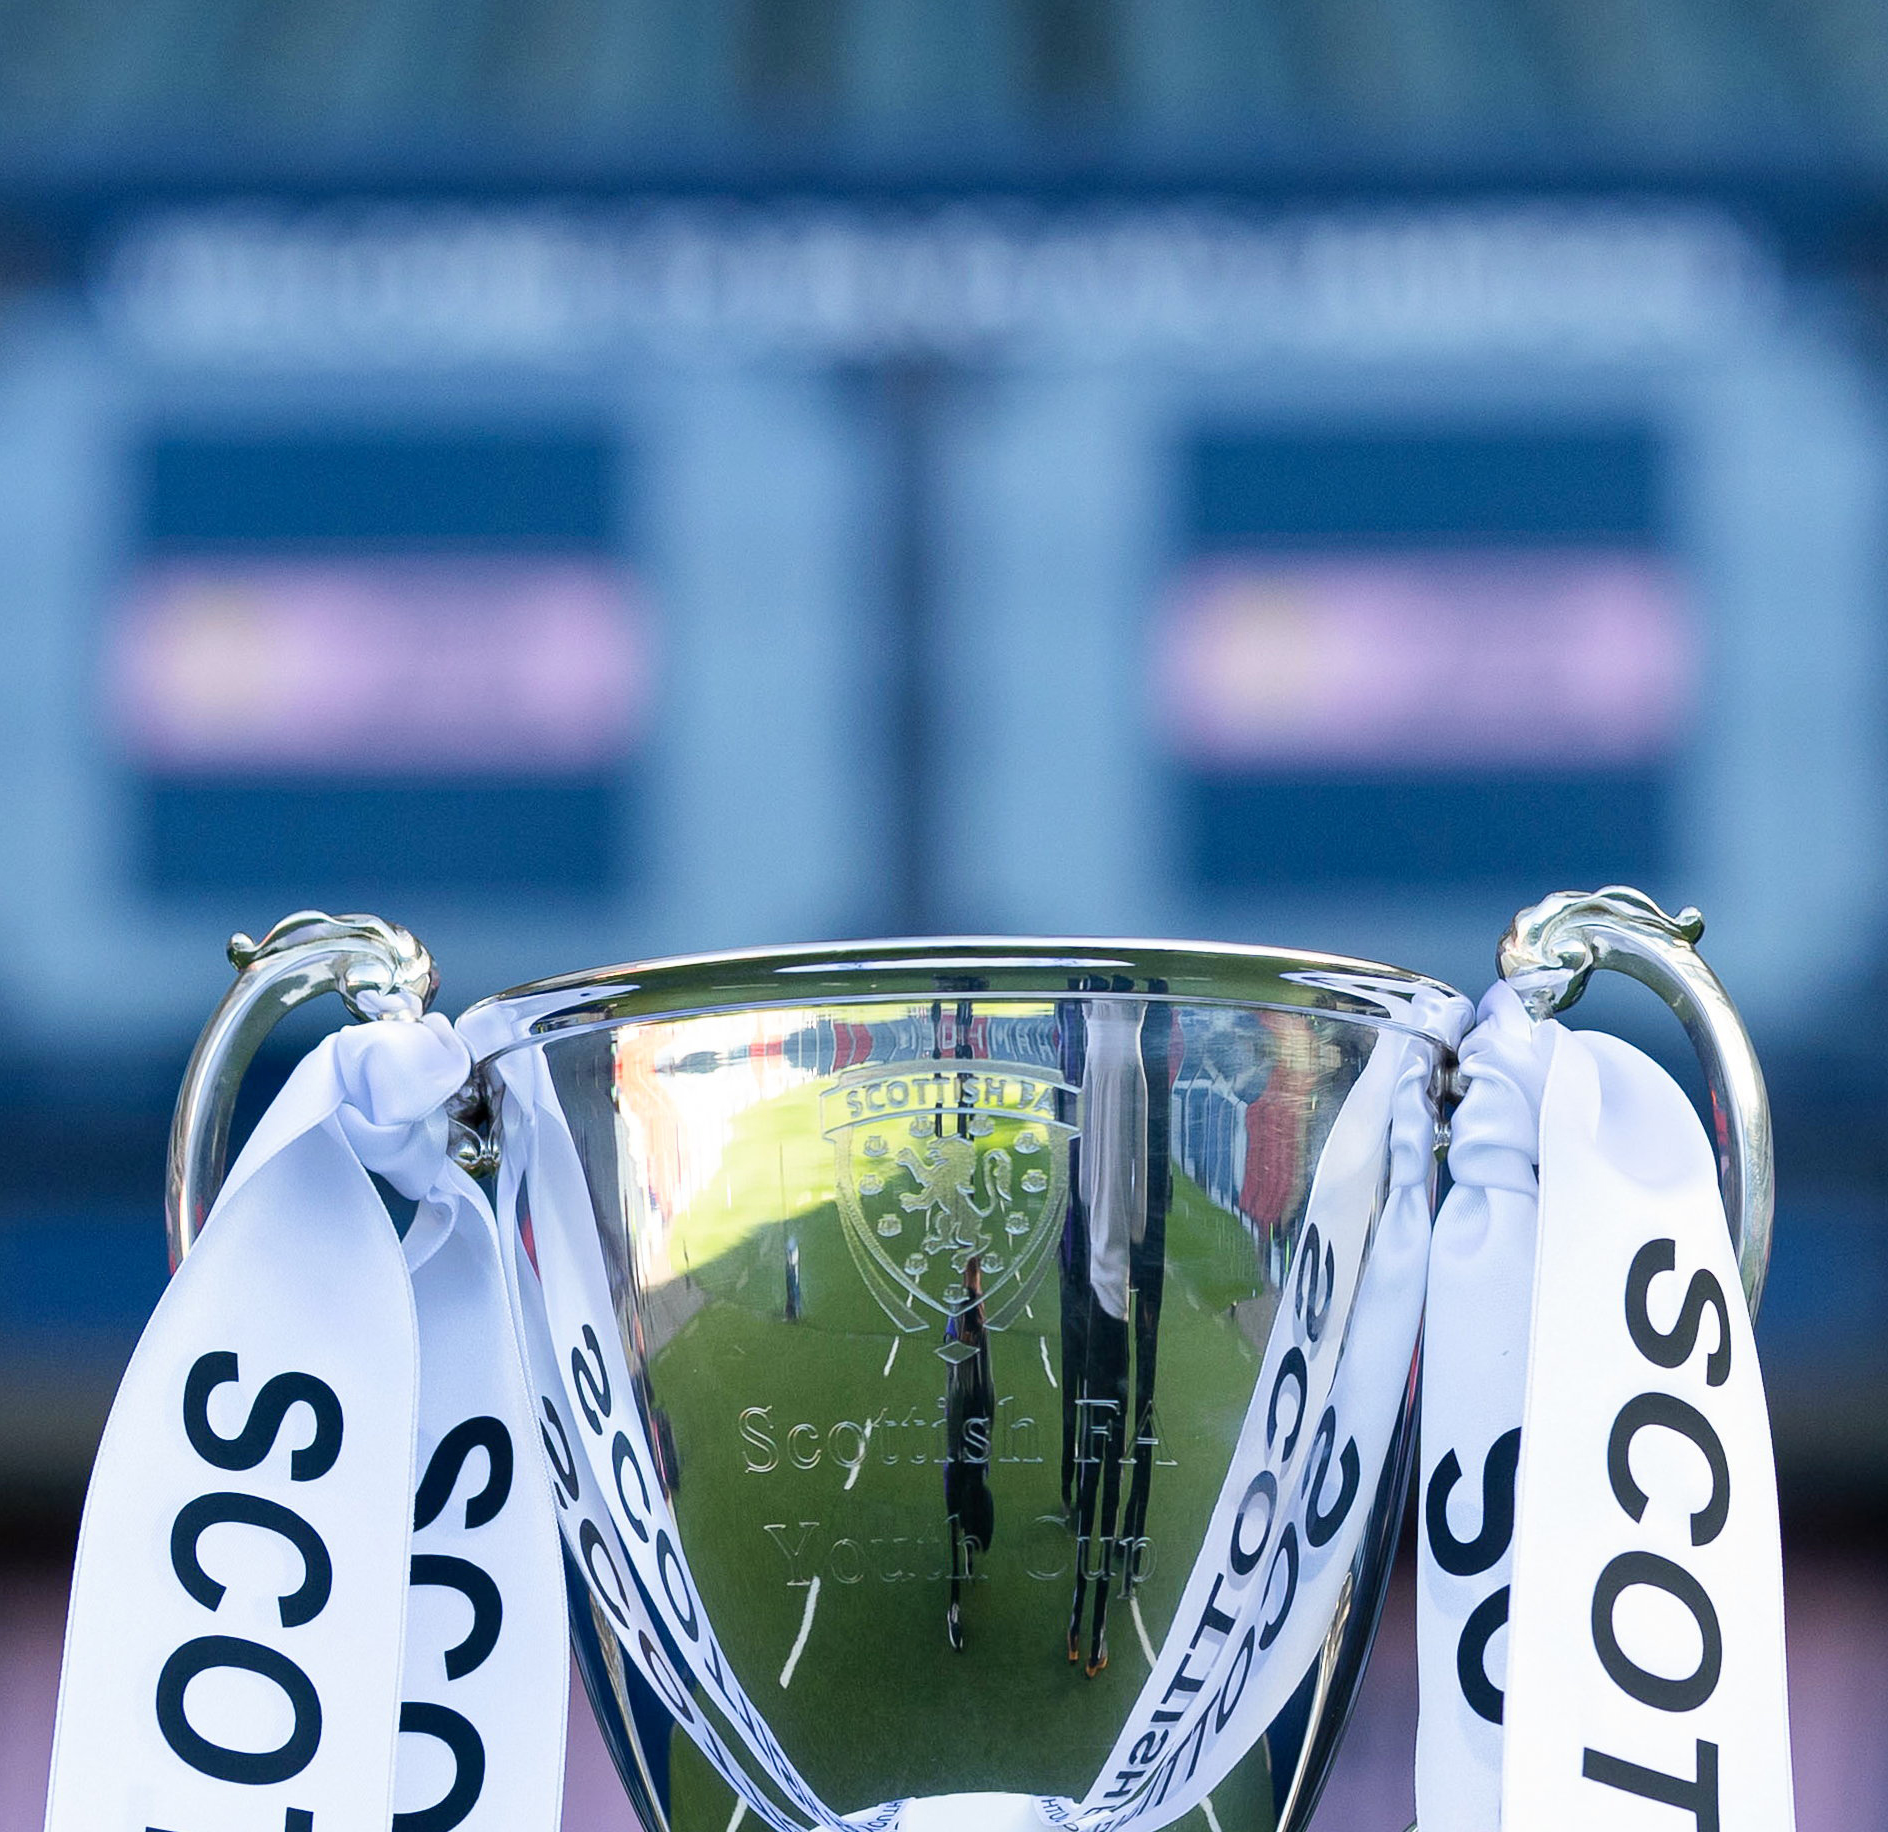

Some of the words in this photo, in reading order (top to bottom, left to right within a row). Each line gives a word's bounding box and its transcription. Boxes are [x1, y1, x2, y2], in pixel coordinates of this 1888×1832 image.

[846, 1076, 1007, 1119] SCOTTISH
[1018, 1081, 1056, 1116] FA
[738, 1396, 1044, 1474] Scottish
[1071, 1399, 1179, 1466] FA
[763, 1512, 989, 1587] Youth
[1025, 1514, 1158, 1600] Cup
